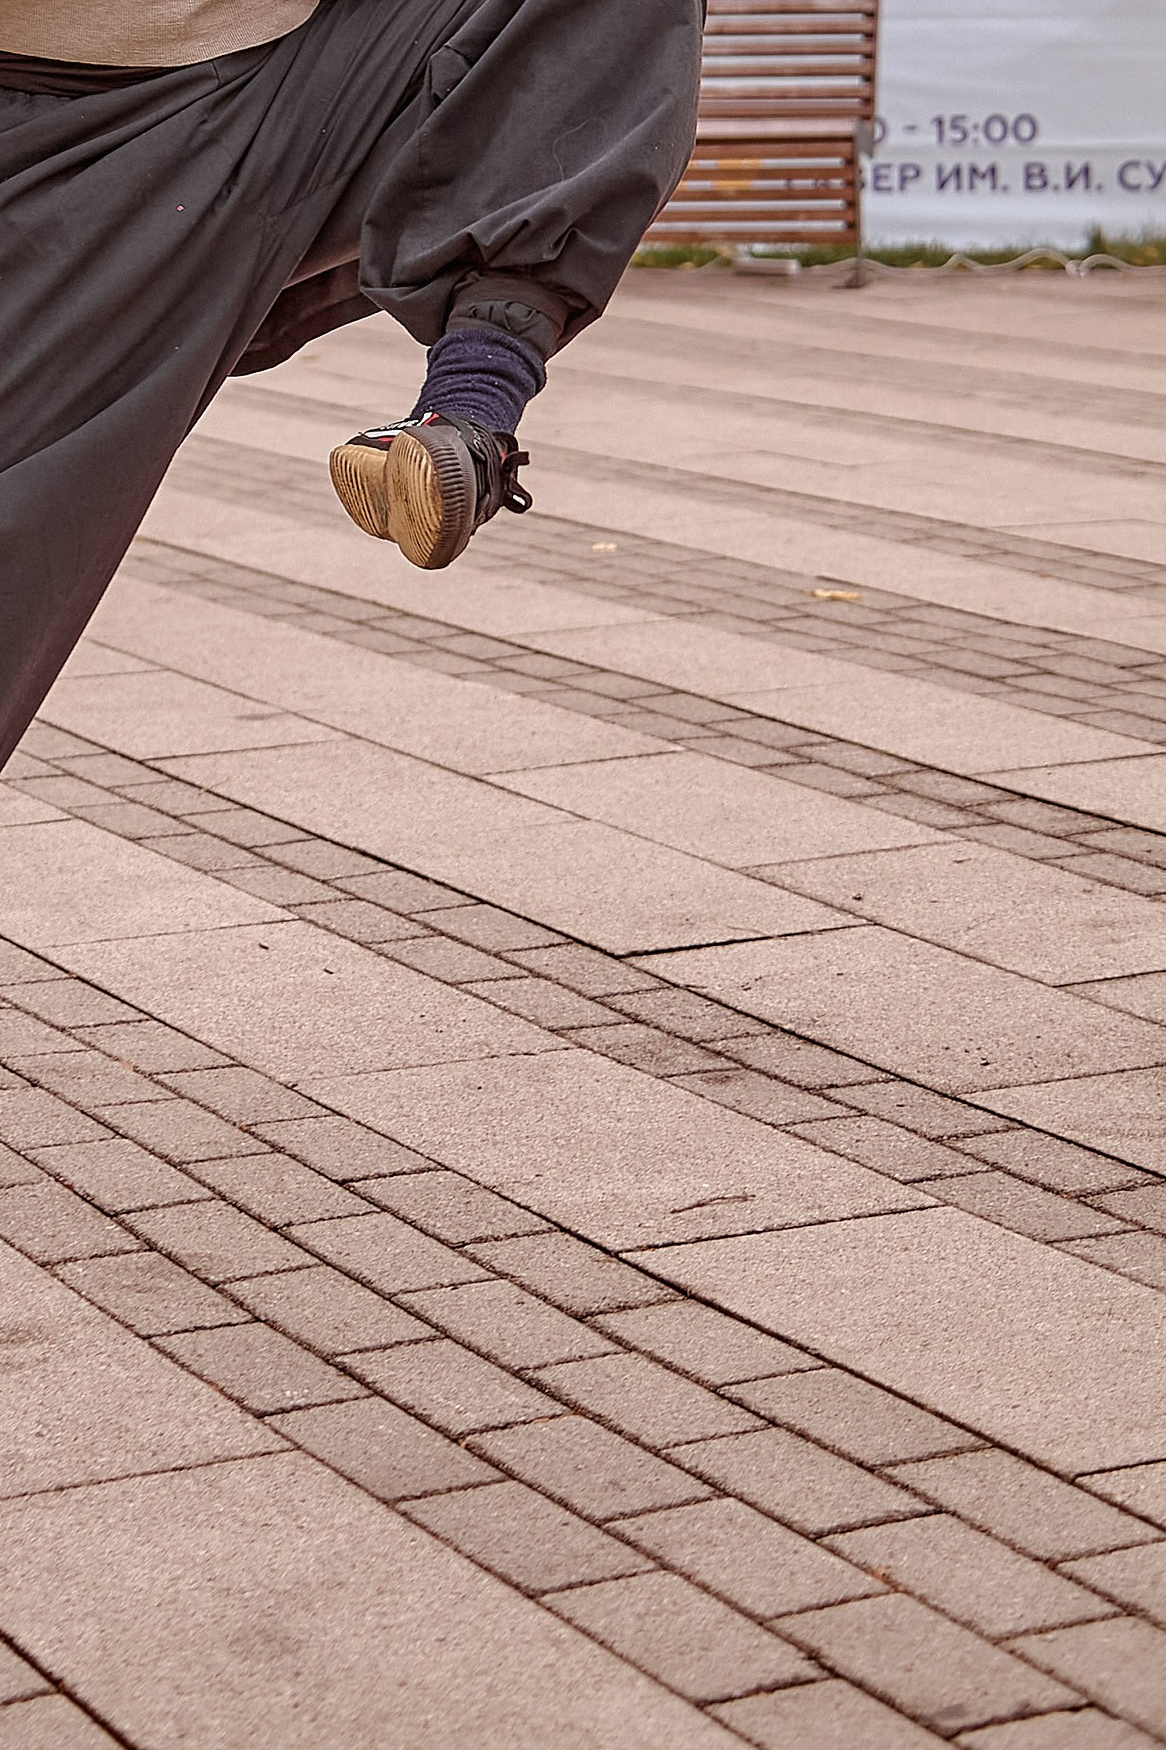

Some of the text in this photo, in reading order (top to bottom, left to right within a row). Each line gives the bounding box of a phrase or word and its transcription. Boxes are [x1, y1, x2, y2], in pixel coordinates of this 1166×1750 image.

[931, 113, 1038, 145] 15:00
[936, 161, 1008, 193] ИМ.
[1022, 161, 1103, 193] В.И.
